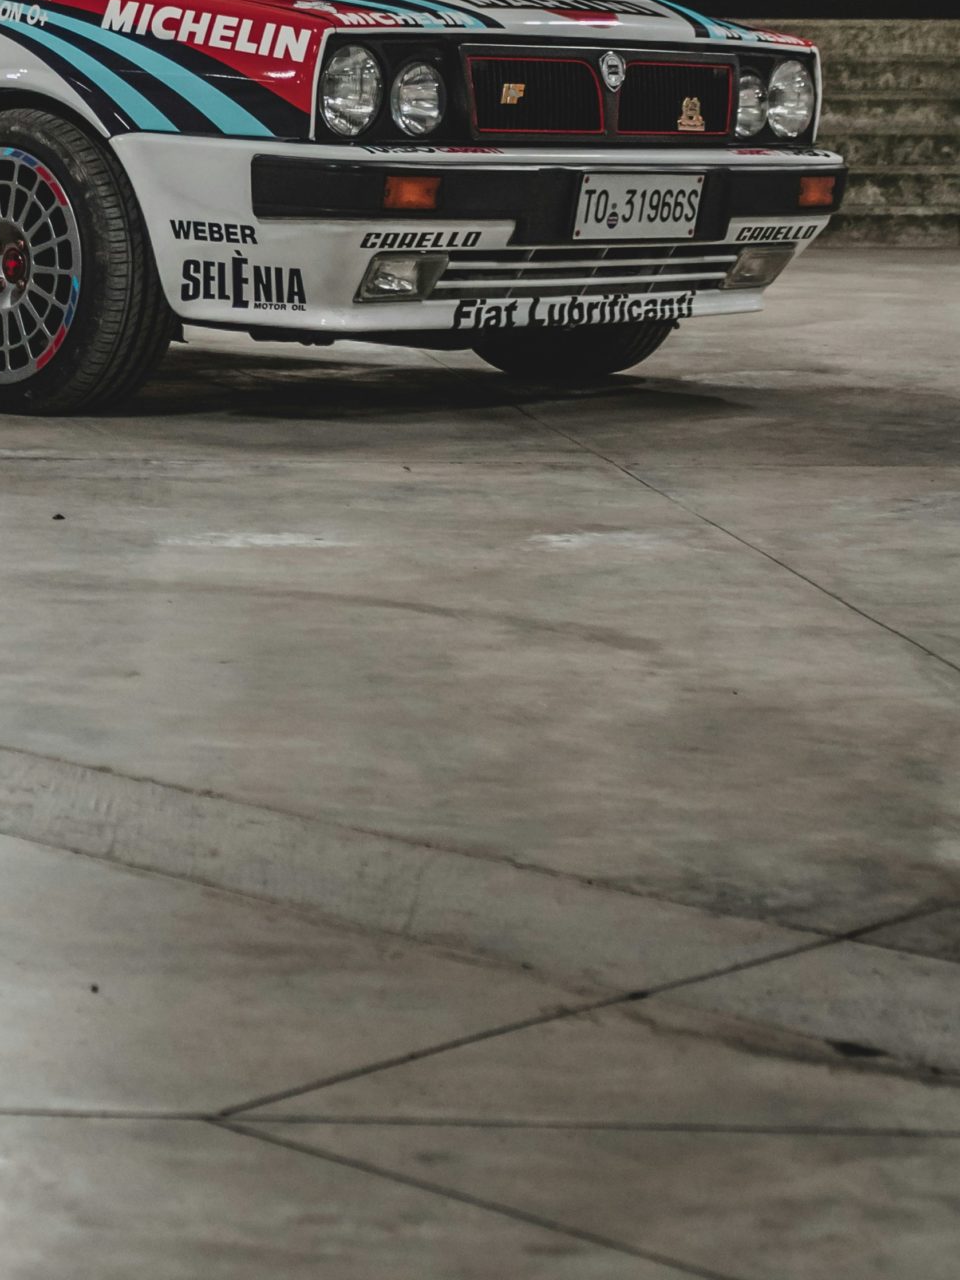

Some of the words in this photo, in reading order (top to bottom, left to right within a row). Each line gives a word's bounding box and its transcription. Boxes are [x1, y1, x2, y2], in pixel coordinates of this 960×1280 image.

[336, 11, 474, 26] MICHELIN
[584, 189, 609, 223] TO
[170, 219, 258, 244] WEBER
[360, 231, 482, 249] CARELLO
[181, 249, 306, 308] SELÈNIA
[253, 302, 287, 311] MOTOR
[451, 298, 518, 329] Fiat
[528, 290, 696, 327] Lubrificanti
